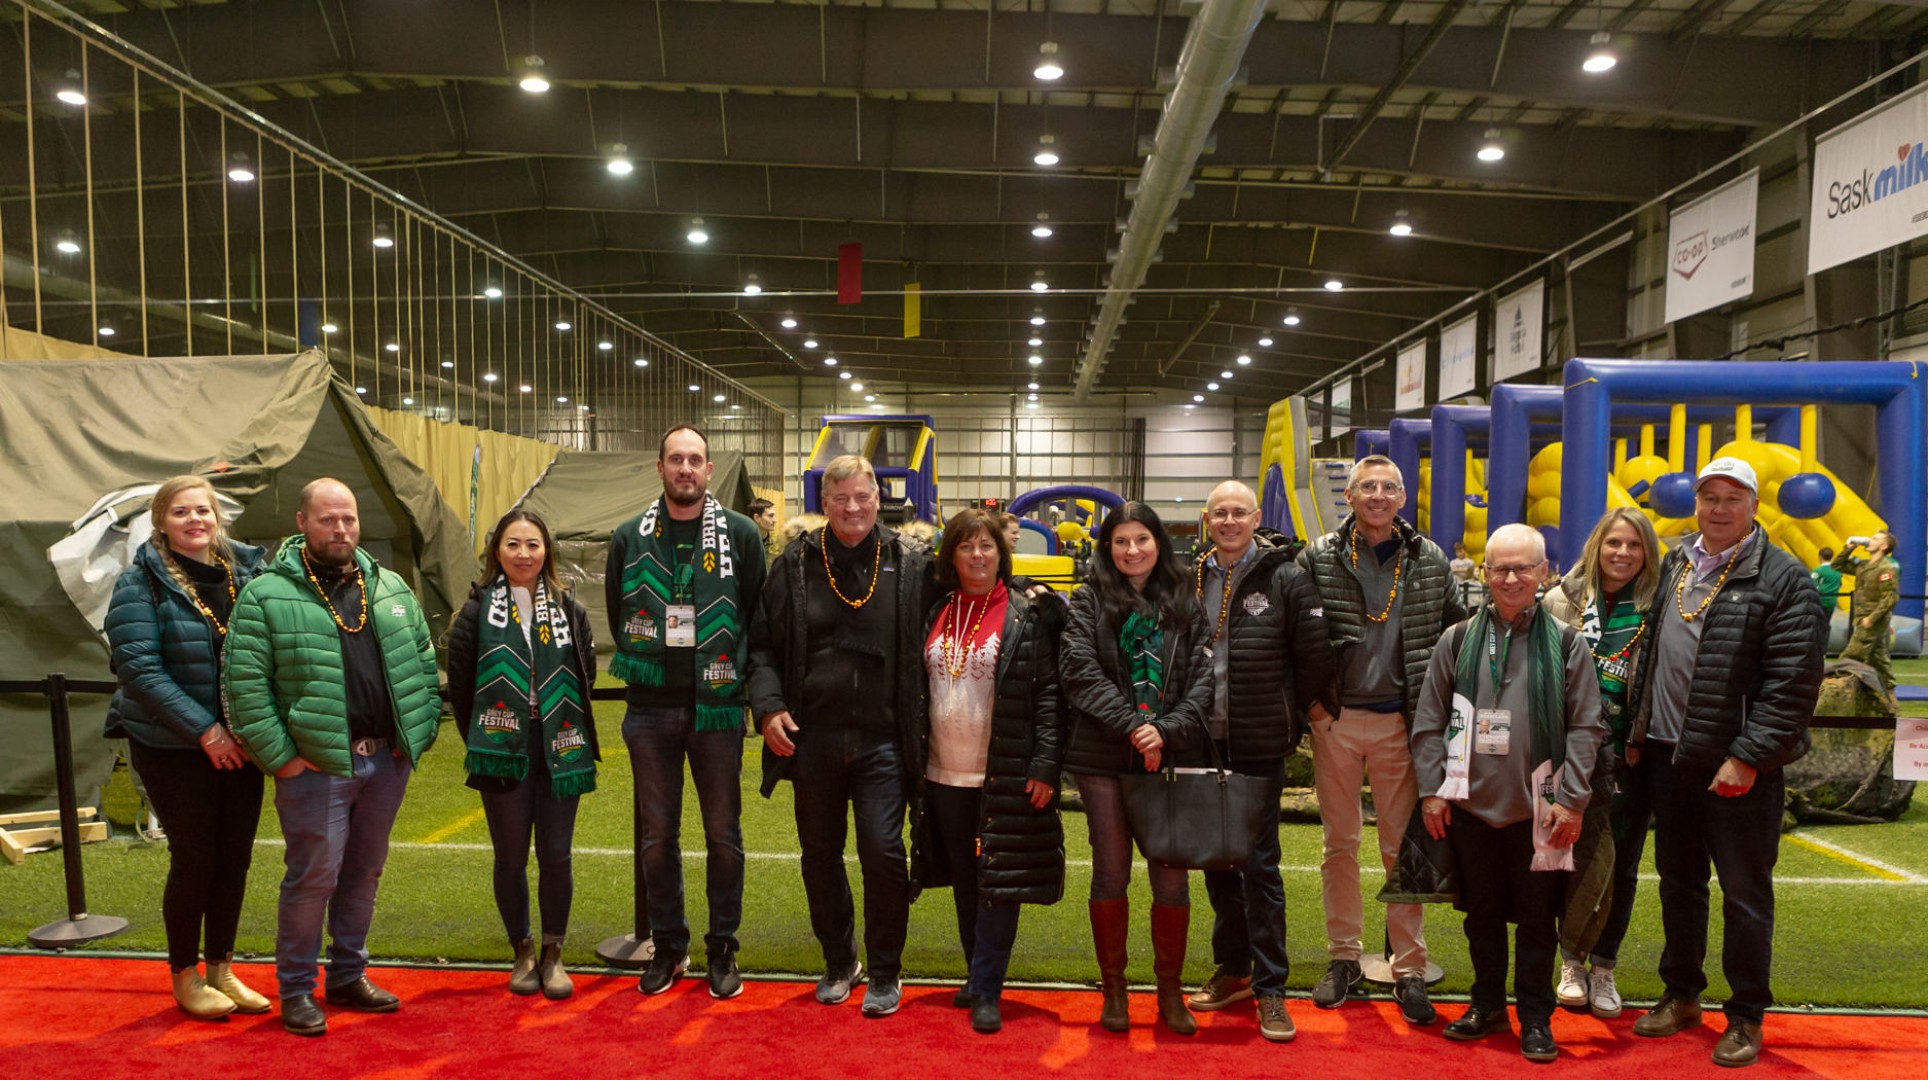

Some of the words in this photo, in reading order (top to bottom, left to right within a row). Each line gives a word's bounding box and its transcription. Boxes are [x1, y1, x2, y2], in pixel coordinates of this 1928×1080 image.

[624, 621, 658, 638] FESTIVAL
[478, 714, 520, 731] FESTIVAL
[552, 733, 586, 752] FESTIVAL
